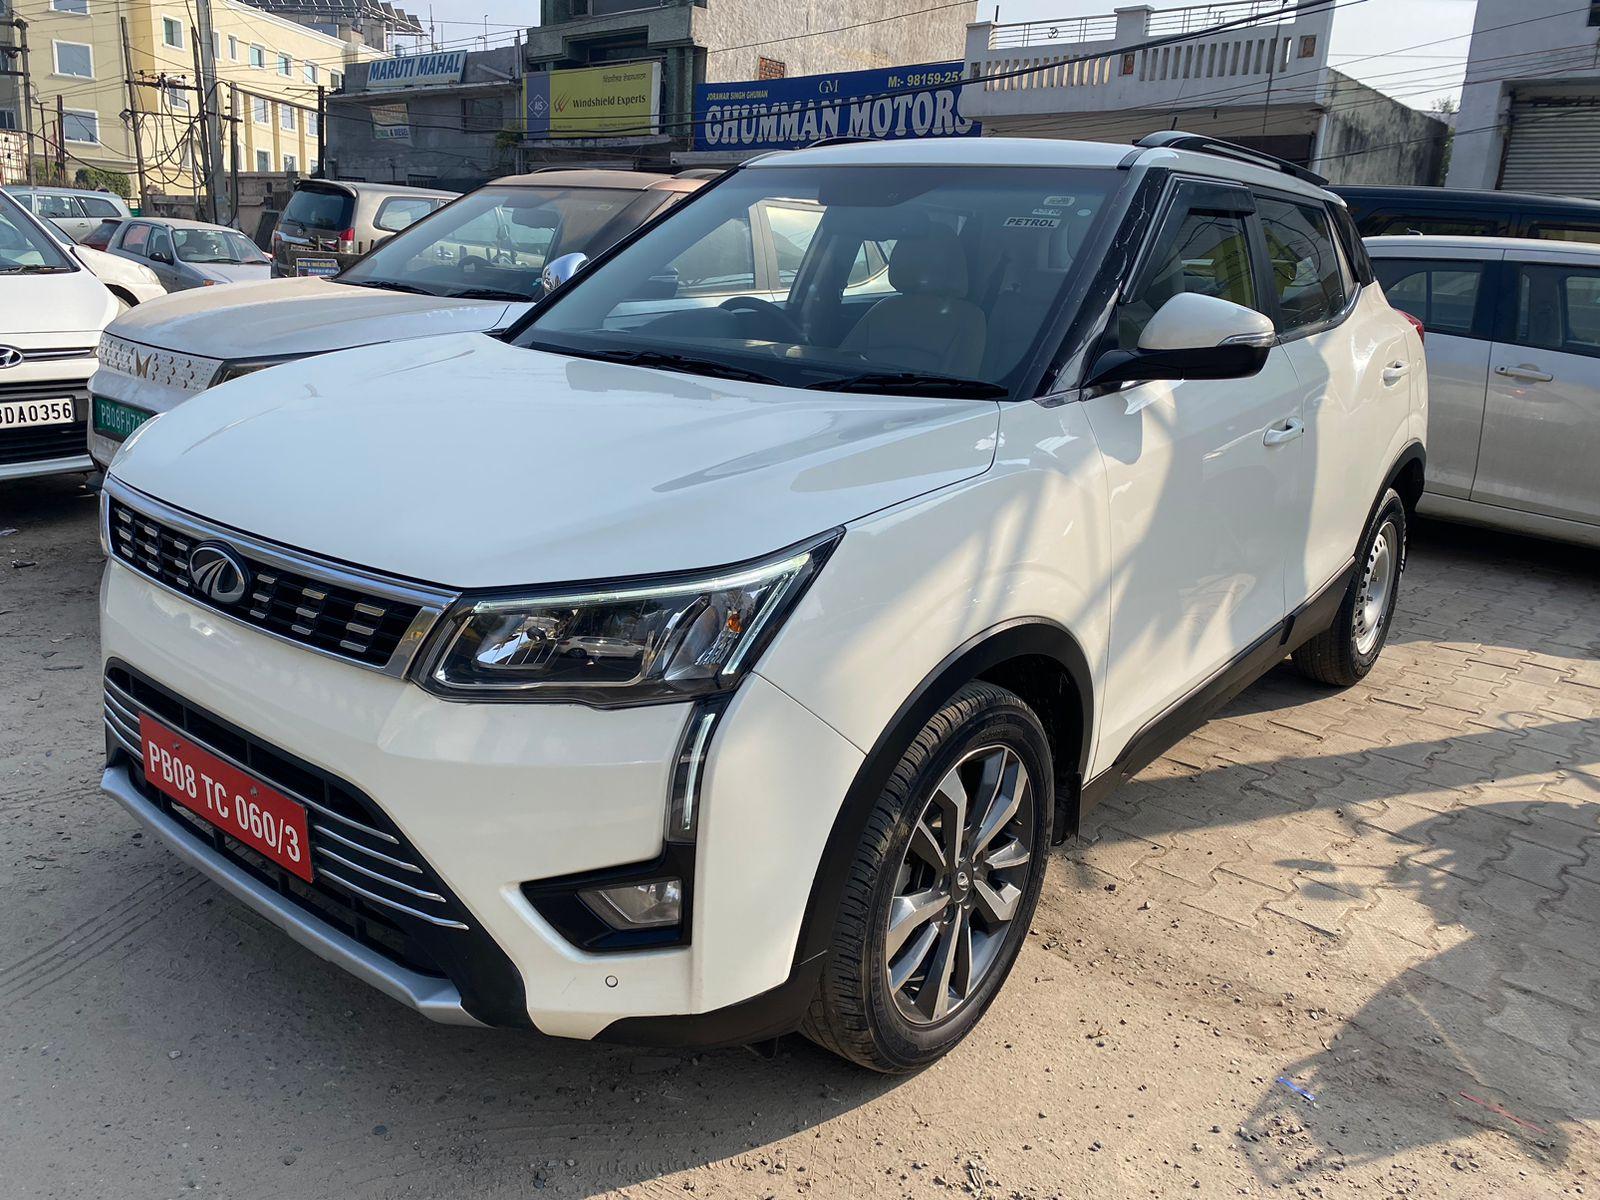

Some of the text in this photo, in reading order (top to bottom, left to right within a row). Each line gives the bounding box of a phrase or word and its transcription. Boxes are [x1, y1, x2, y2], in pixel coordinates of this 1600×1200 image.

[369, 54, 460, 81] MARUTI MAHAL
[819, 80, 839, 93] GM
[573, 94, 646, 108] Windshield Experts
[705, 90, 974, 145] GHUMMAN MOTORS
[1007, 218, 1055, 227] PETROL
[0, 402, 72, 424] DA0356
[101, 404, 146, 434] PB08FH7
[148, 741, 301, 862] PB08 TC 060/3
